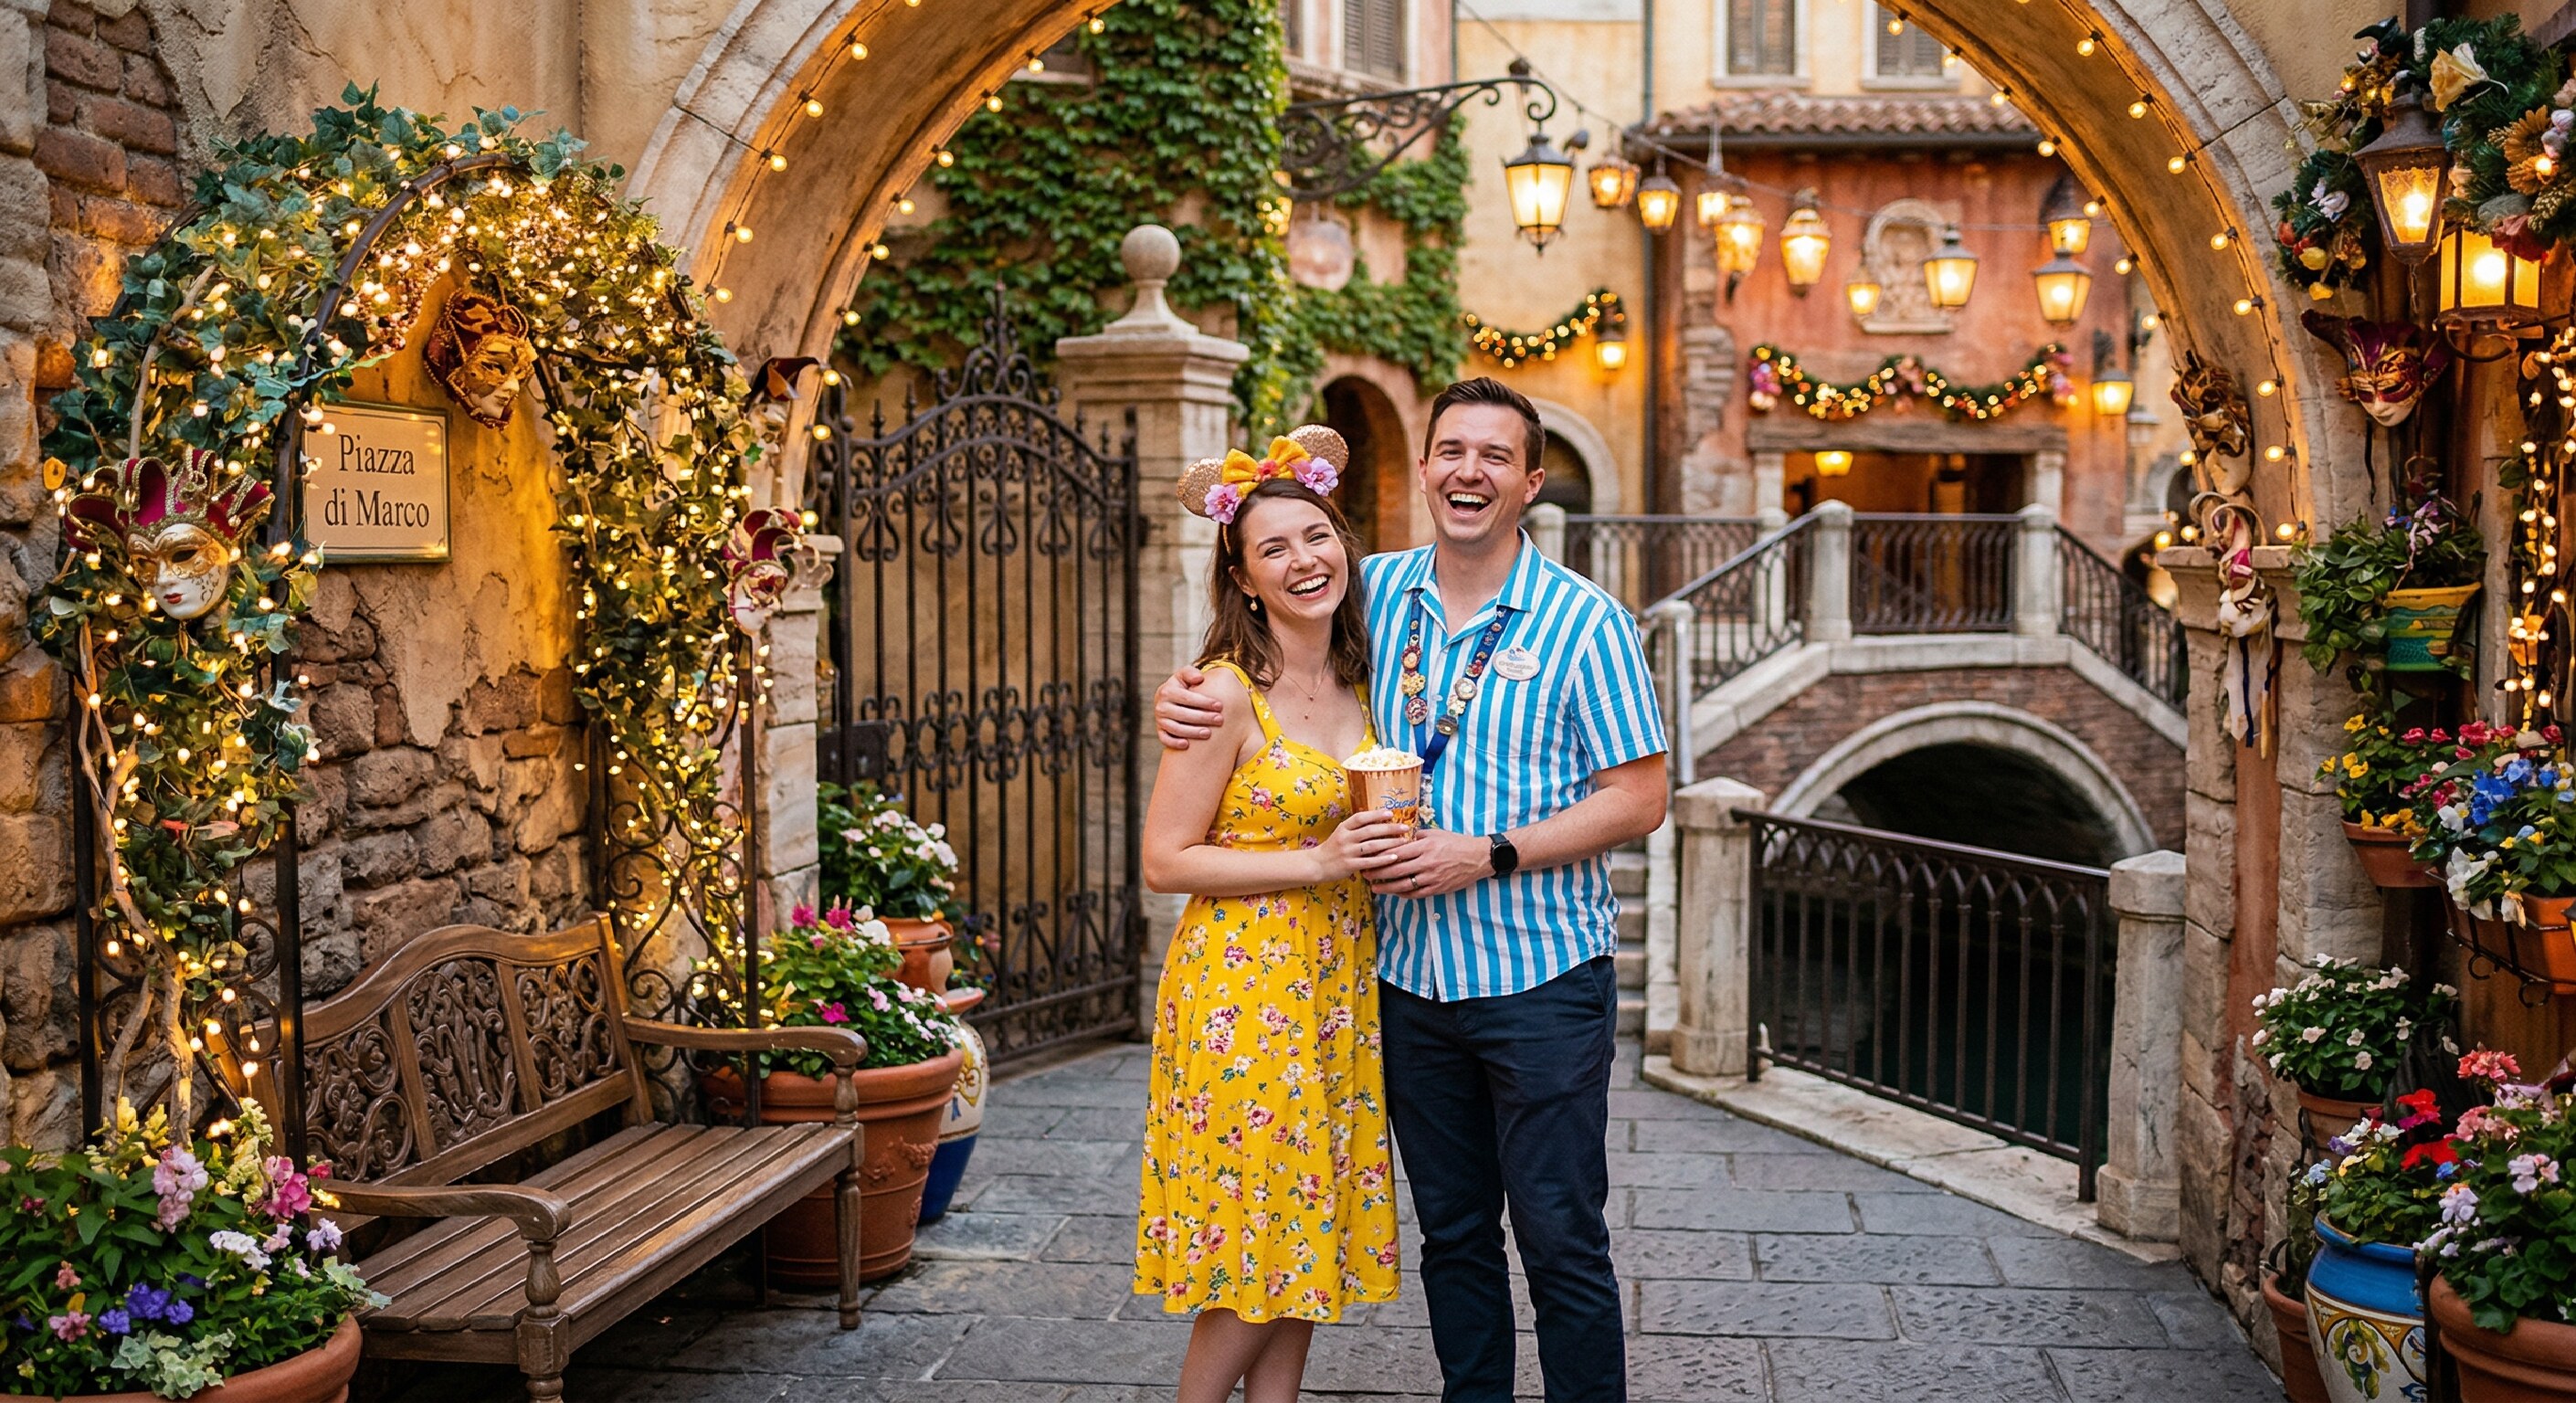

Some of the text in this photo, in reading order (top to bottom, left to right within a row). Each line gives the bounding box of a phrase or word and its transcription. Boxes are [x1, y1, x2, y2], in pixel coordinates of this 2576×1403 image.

[339, 434, 415, 474] Piazza
[324, 488, 429, 527] di Marco
